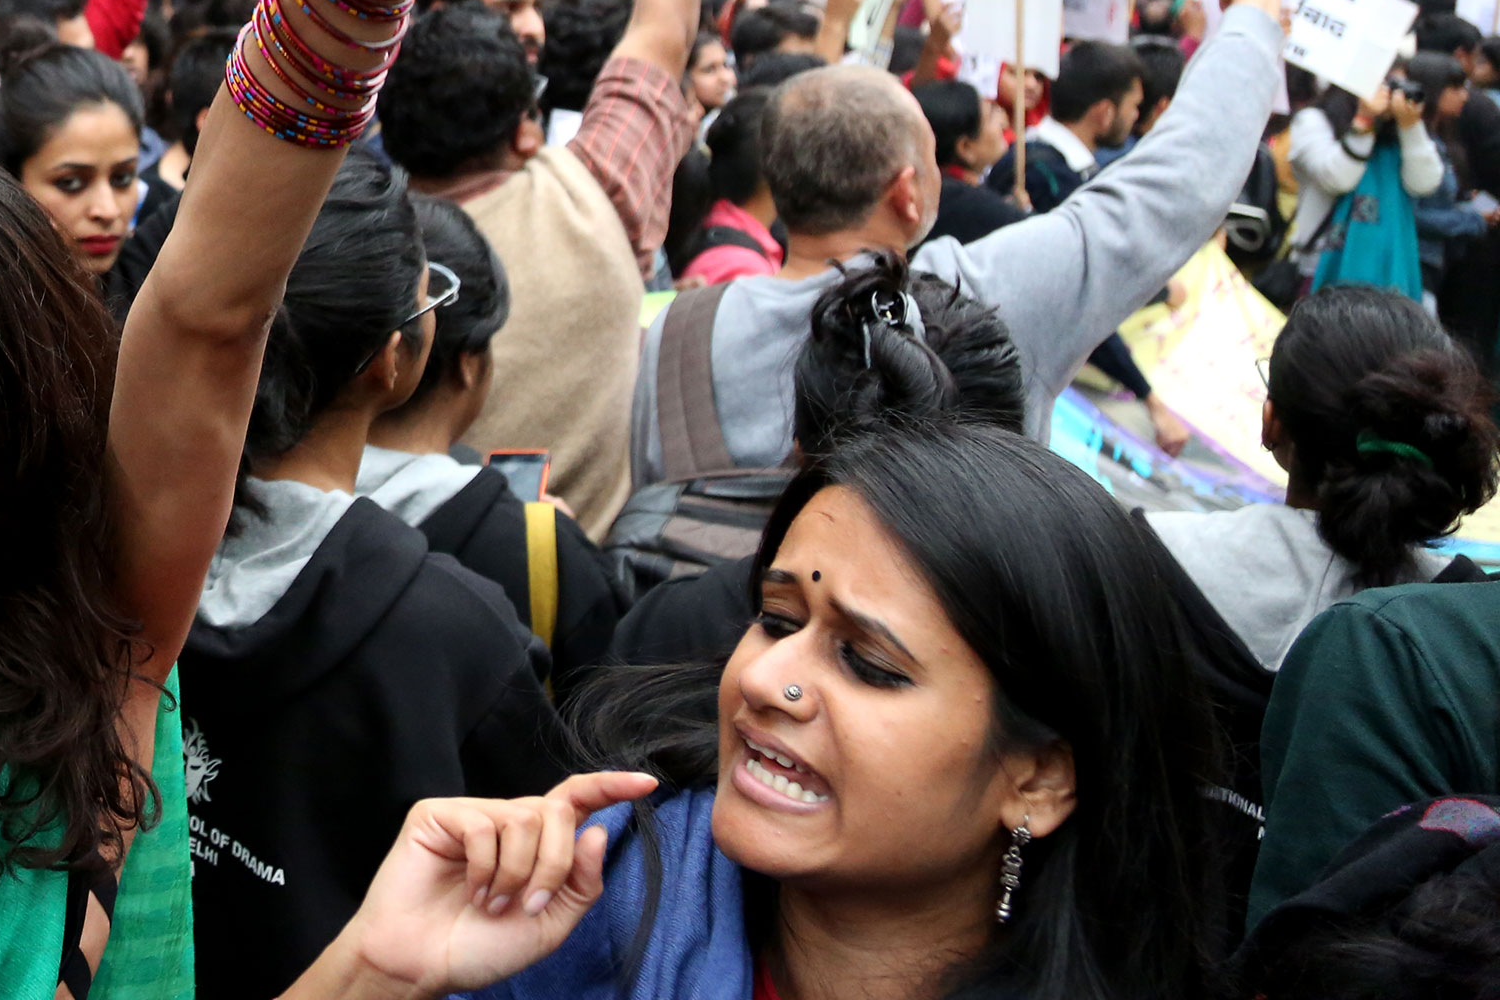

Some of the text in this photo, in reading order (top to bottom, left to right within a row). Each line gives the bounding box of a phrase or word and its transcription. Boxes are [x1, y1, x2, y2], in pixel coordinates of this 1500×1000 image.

[188, 815, 285, 886] OL OF DRAMA
